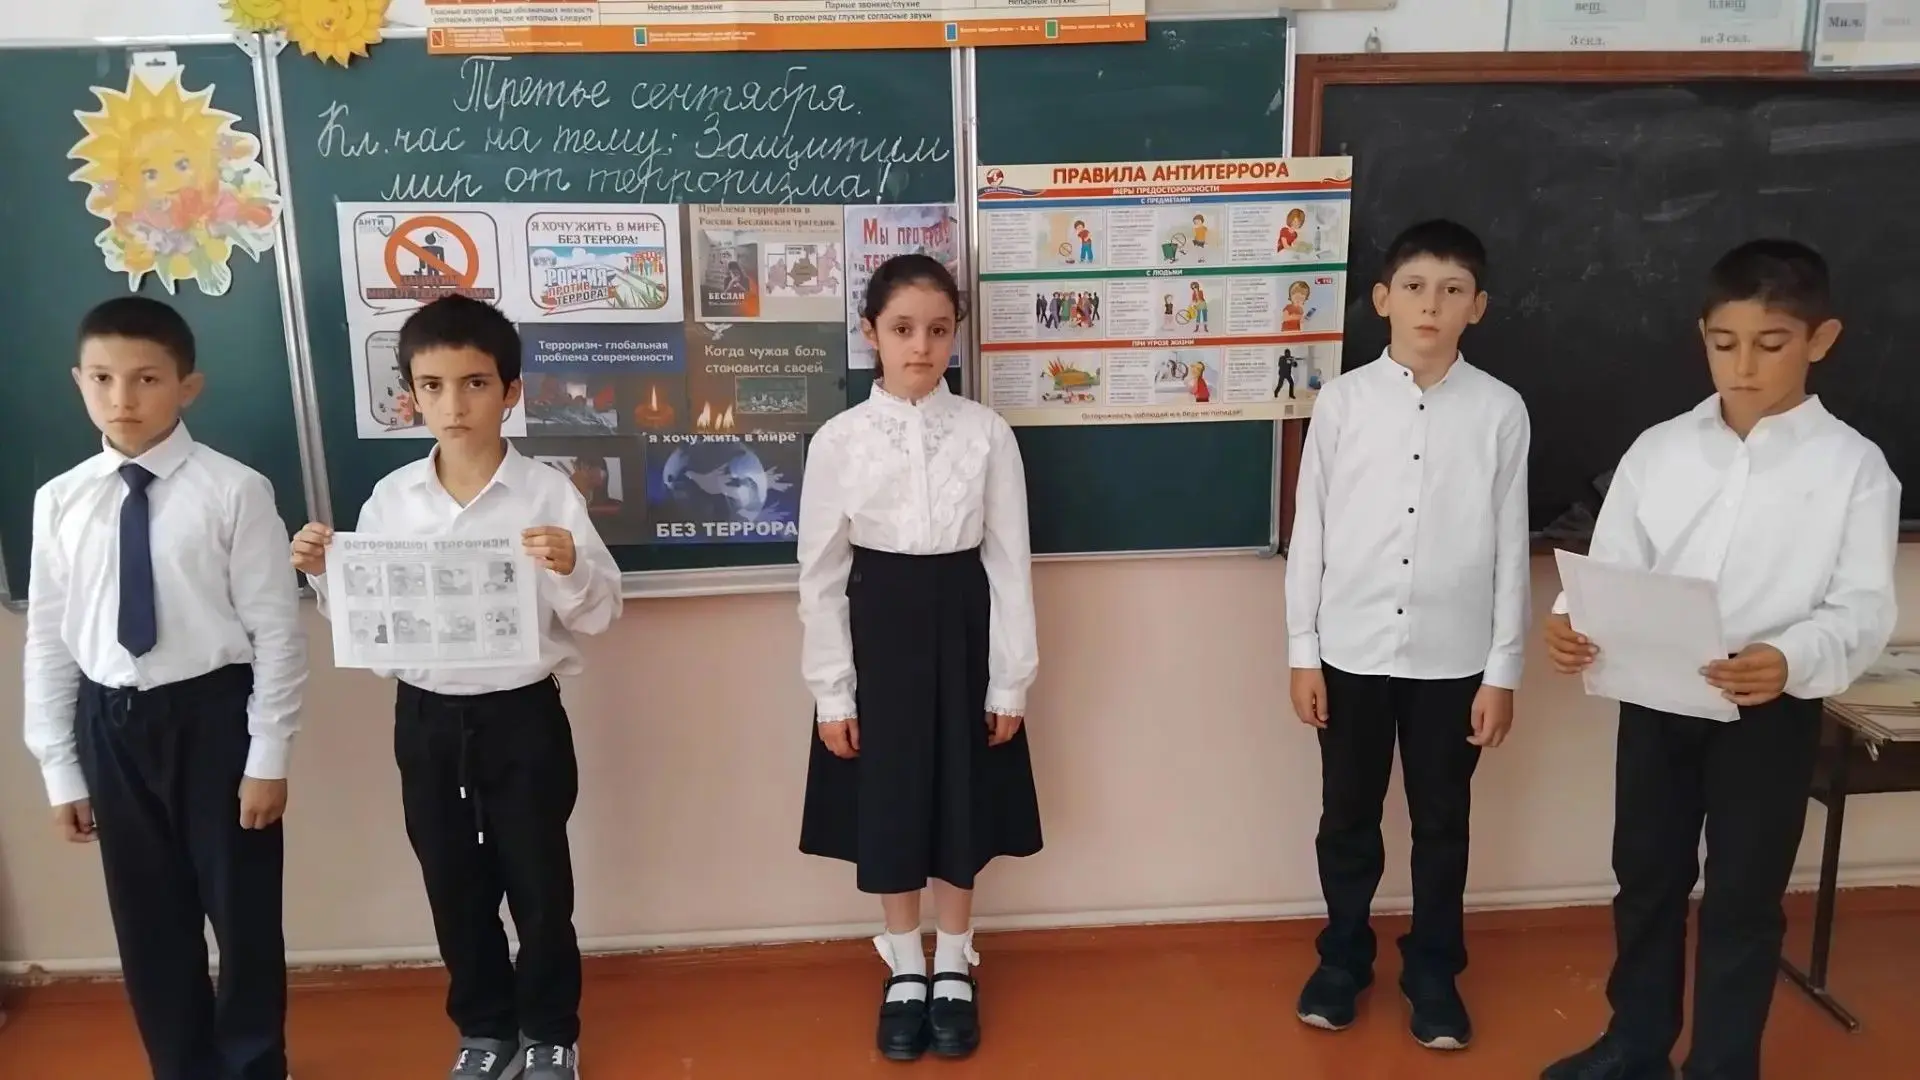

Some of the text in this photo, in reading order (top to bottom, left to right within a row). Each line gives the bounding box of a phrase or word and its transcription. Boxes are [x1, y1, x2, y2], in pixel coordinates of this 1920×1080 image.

[648, 3, 688, 12] Непарные
[825, 1, 856, 9] Парные
[774, 12, 932, 22] Во втором ряду глухие согласные звуки
[453, 55, 862, 138] Третье сентября.
[485, 125, 542, 154] на
[695, 111, 950, 170] Защитим
[1053, 162, 1290, 185] ПРАВИЛА АНТИТЕРРОРА
[381, 158, 894, 204] мир от терроризма!
[1112, 185, 1220, 195] МЕРЫ ПРЕДОСТОРОЖНОСТИ
[1146, 196, 1191, 205] ПРЕДМЕТАМИ
[698, 204, 745, 215] Проблема
[748, 206, 802, 216] терроризма
[358, 218, 385, 227] АНТИ
[531, 221, 660, 232] Я ХОЧУ ЖИТЬ В МИРЕ
[737, 217, 792, 226] Бесланская
[558, 234, 639, 245] БЕЗ ТЕРРОРА!
[545, 267, 608, 287] РОССИЯ
[1152, 268, 1183, 277] ЛЮДЬМИ
[548, 281, 592, 298] ПРОТИВ
[556, 286, 609, 305] ТЕРРОРА!
[708, 292, 745, 300] БЕСЛАН
[605, 340, 668, 351] глобальная
[1132, 338, 1195, 347] ПРИ УГРОЗЕ ЖИЗНИ
[704, 344, 827, 360] Когда чужая боль
[535, 352, 674, 364] проблема современности
[705, 363, 779, 374] становится
[663, 434, 697, 446] хочу
[702, 433, 740, 443] жить
[745, 433, 753, 442] в
[656, 520, 798, 538] БЕЗ ТЕРРОРА
